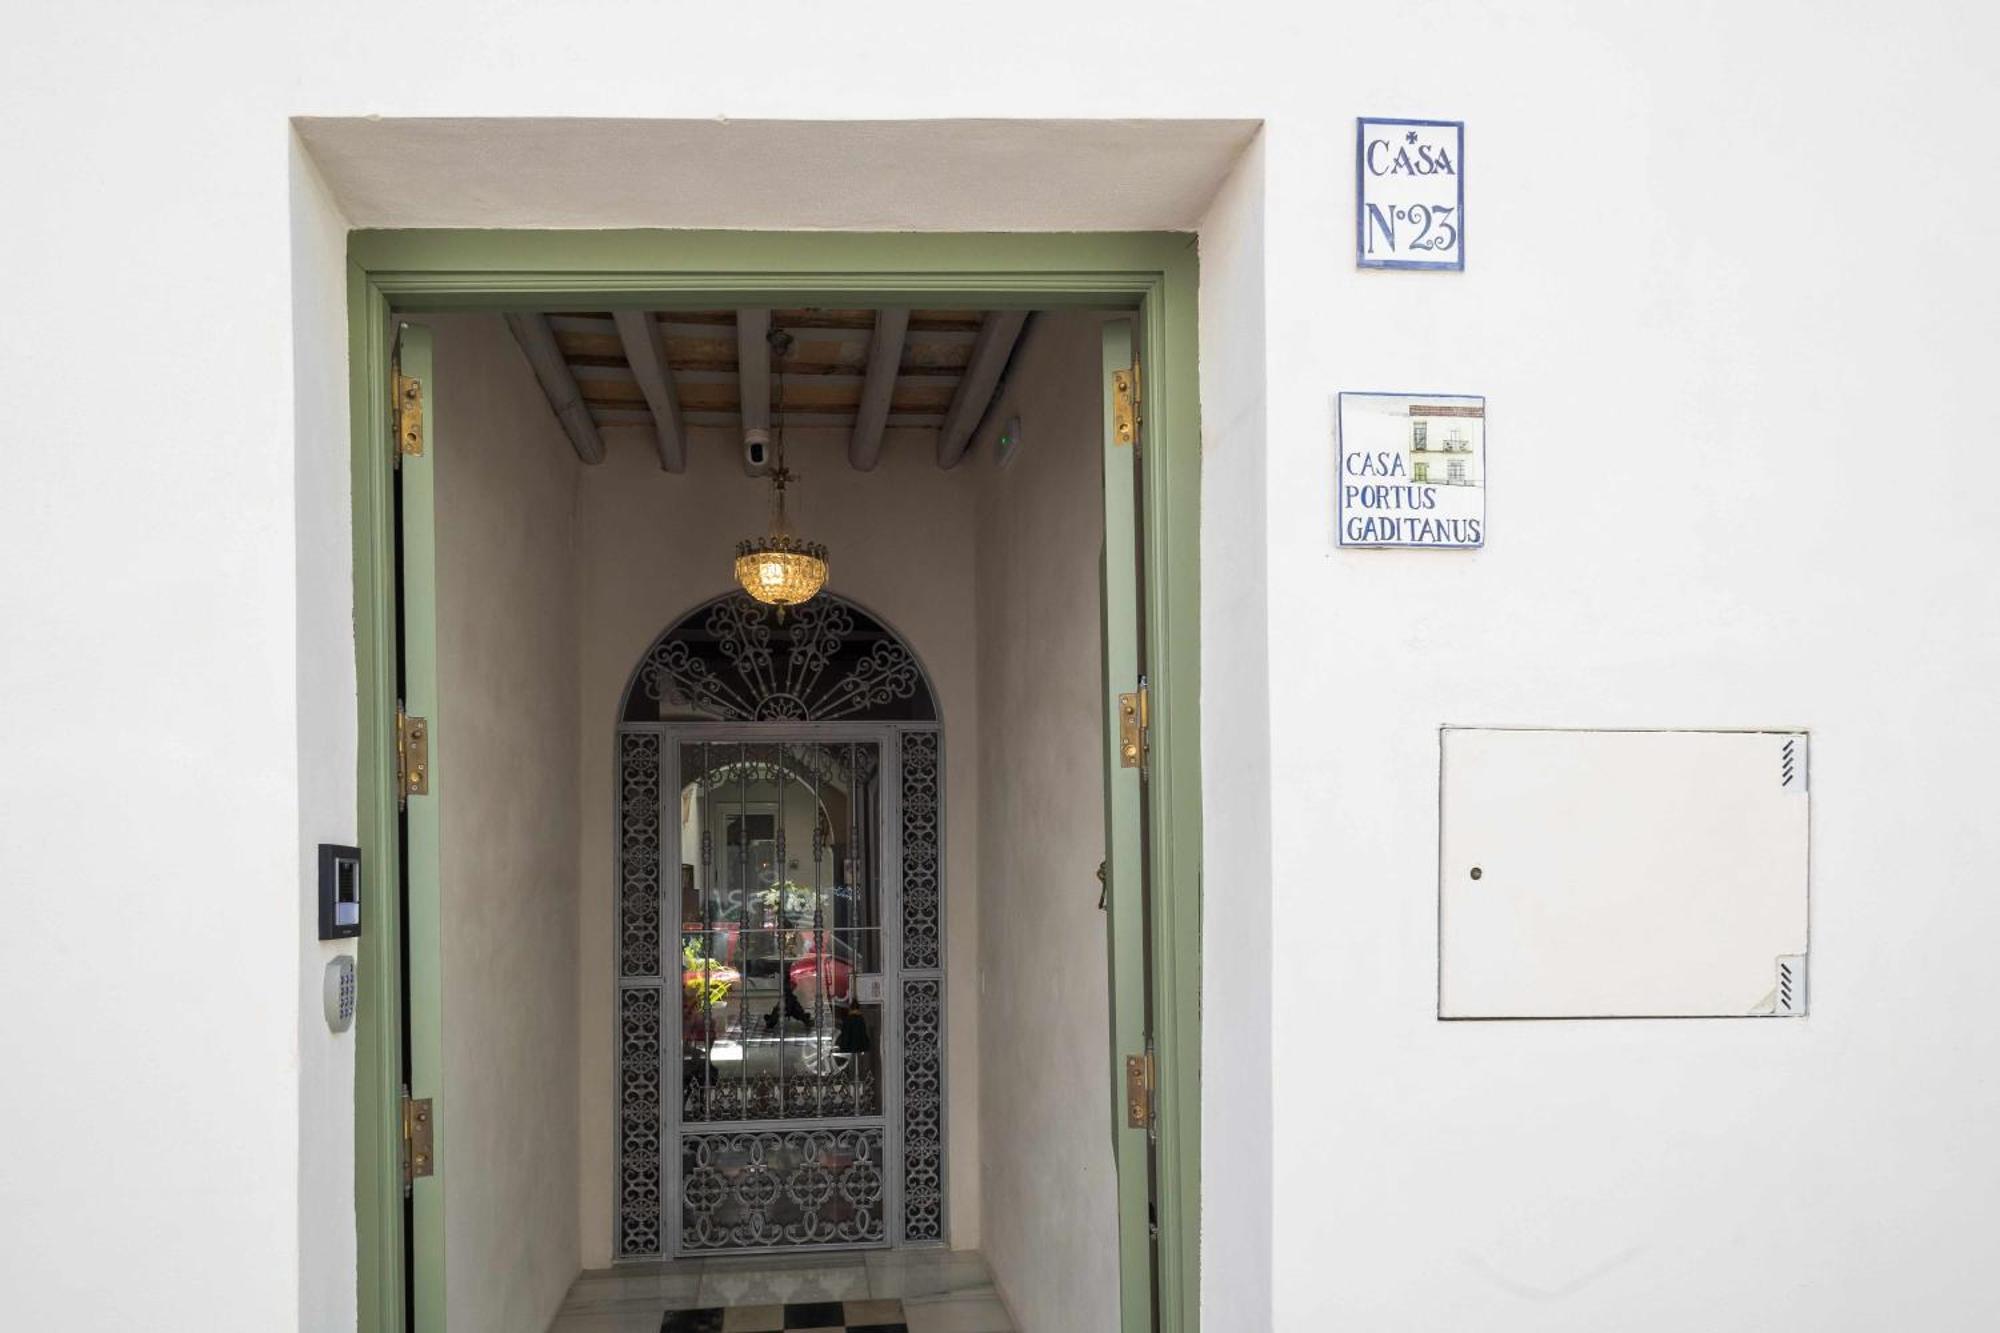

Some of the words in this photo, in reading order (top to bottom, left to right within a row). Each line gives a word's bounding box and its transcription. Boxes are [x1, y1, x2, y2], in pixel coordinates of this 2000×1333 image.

[1367, 139, 1455, 176] CASA
[1346, 451, 1406, 476] CASA
[1345, 485, 1437, 510] PORTUS
[1347, 516, 1481, 543] GADITANUS
